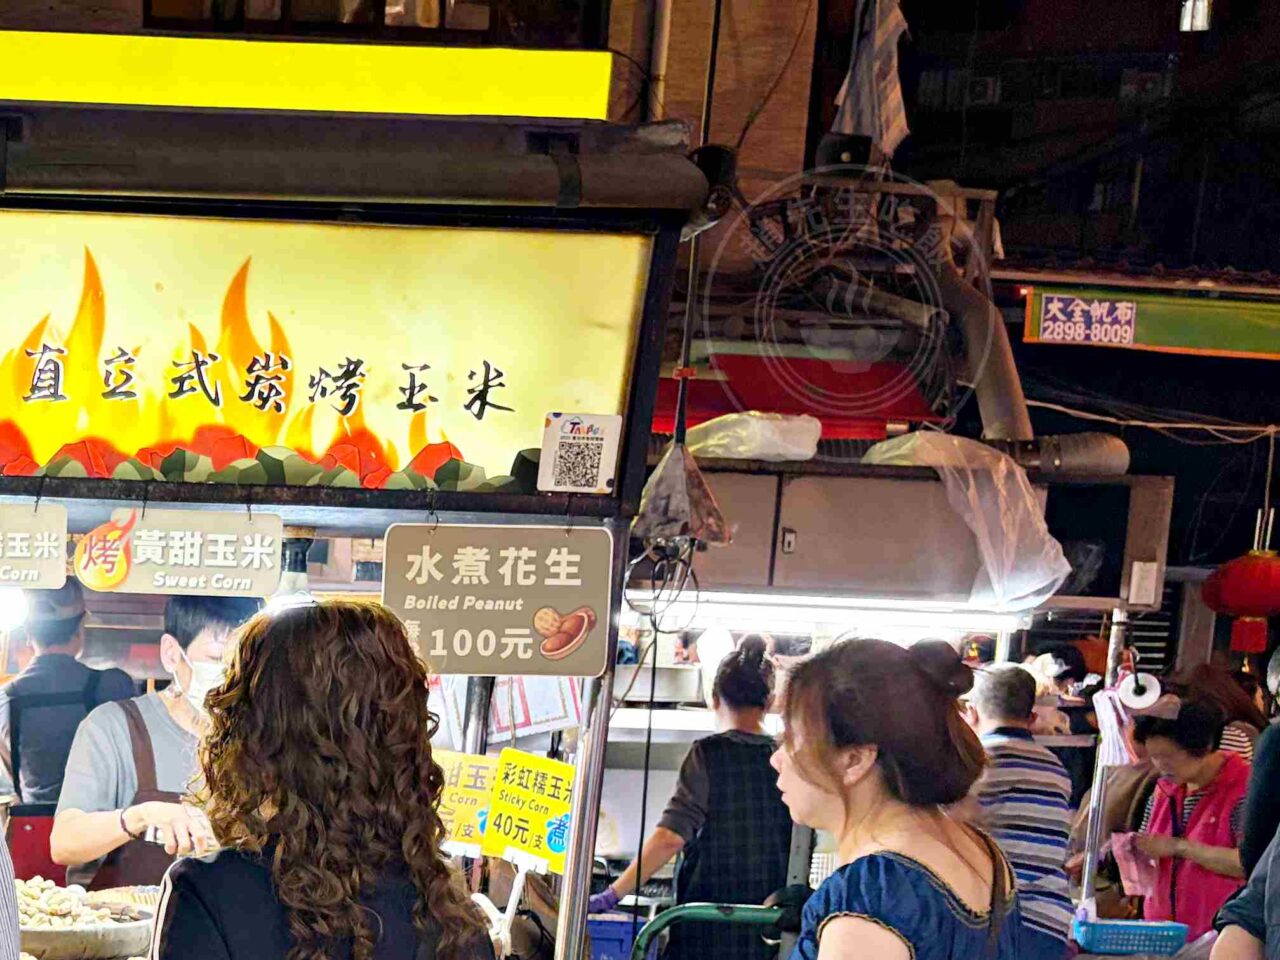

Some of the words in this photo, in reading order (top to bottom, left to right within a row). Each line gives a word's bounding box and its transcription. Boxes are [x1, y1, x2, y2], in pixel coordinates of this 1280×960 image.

[1045, 297, 1133, 323] 大全帆布
[1043, 321, 1131, 344] 2898-8009
[22, 343, 517, 420] 直立式炭烤玉米
[81, 534, 120, 577] 烤
[134, 528, 276, 571] 黃甜玉米
[405, 545, 582, 586] 水煮花生
[153, 571, 204, 590] Sweet
[208, 574, 252, 591] Corn
[404, 594, 460, 610] Boiled
[463, 596, 524, 611] Peanut
[430, 628, 534, 659] 100元
[450, 792, 478, 806] Corn
[499, 789, 526, 810] Sticky
[528, 799, 550, 816] Corn
